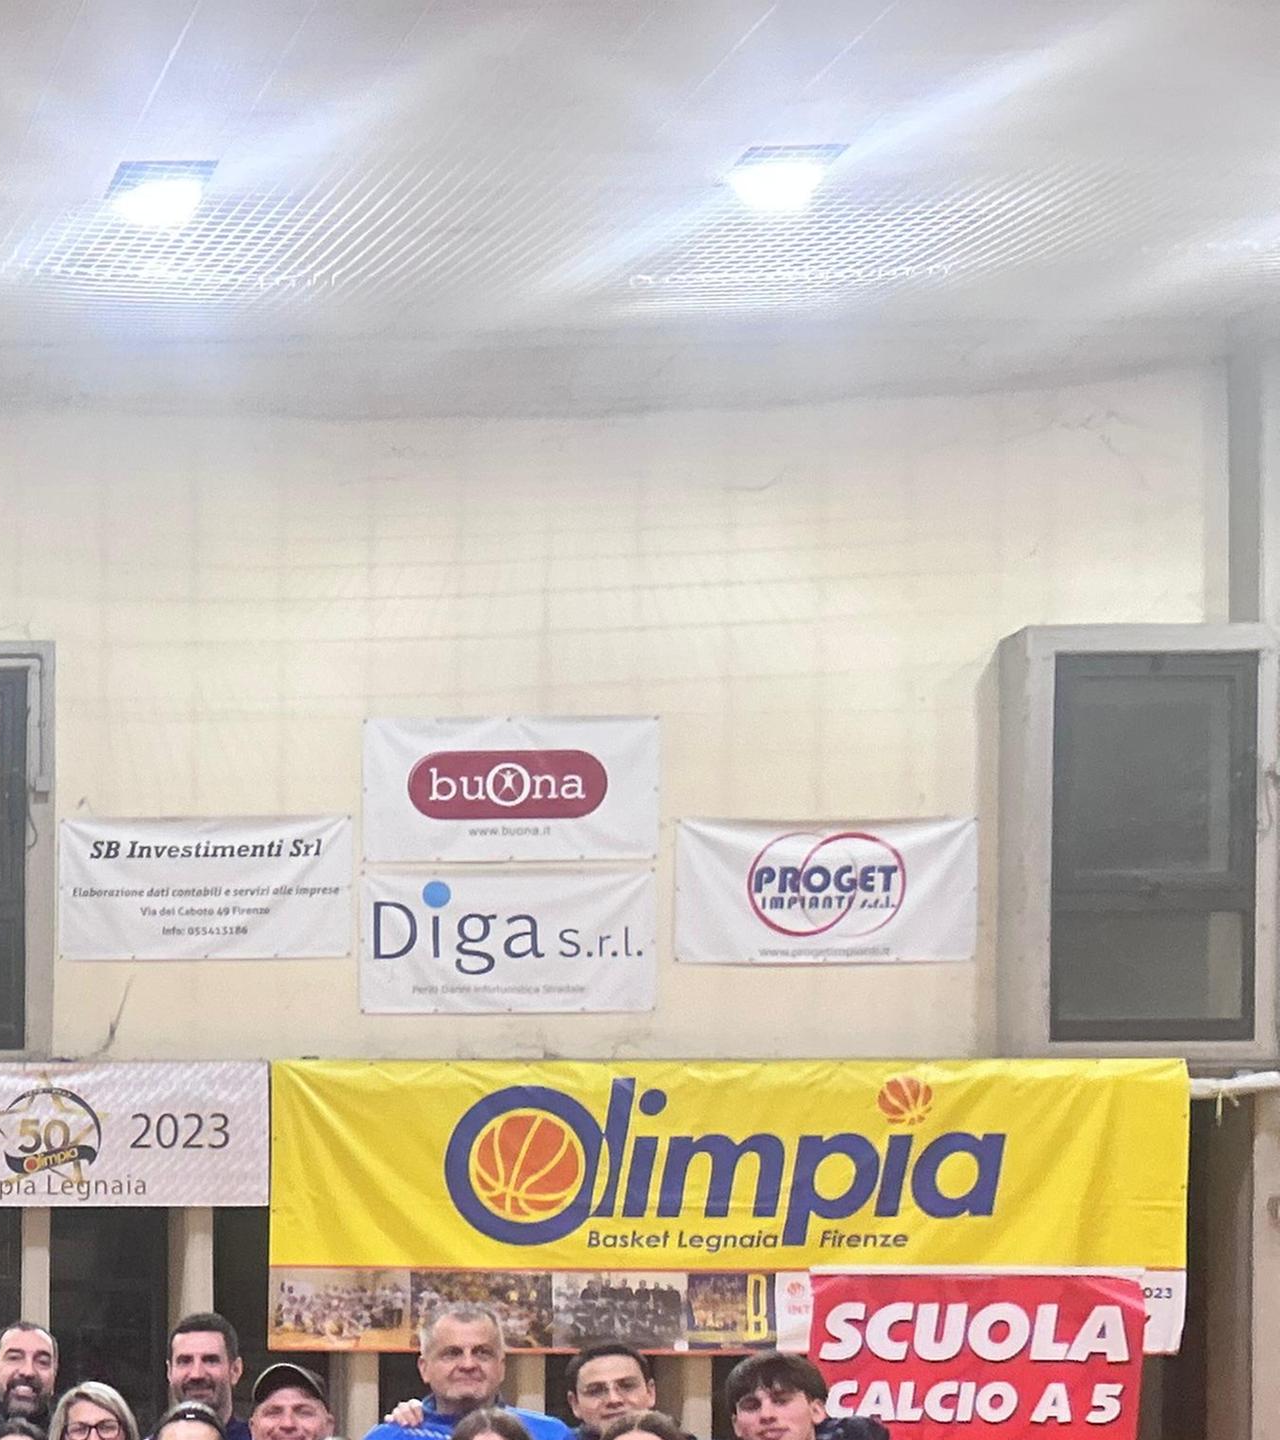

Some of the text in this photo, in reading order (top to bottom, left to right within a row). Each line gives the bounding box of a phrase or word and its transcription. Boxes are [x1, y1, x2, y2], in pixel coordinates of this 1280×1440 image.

[468, 826, 551, 837] www.buona.it
[89, 838, 323, 860] SB Investimenti Srl
[72, 887, 144, 898] Elaborazione
[146, 887, 170, 898] dati
[171, 886, 223, 898] contabili
[233, 886, 270, 897] servizi
[273, 885, 293, 896] alle
[295, 885, 340, 898] imprese
[753, 864, 898, 894] PROGET
[140, 906, 157, 917] Via
[177, 906, 215, 917] Caboto
[216, 906, 231, 917] 49
[232, 905, 270, 916] Firenze
[162, 925, 184, 936] Info:
[373, 881, 644, 975] Diga s.r.l.
[18, 1118, 71, 1154] 50
[129, 1113, 231, 1150] 2023
[444, 1076, 1008, 1247] Olimpia
[46, 1174, 148, 1201] Legnaia
[587, 1228, 910, 1254] Basket Legnaia Firenze
[819, 1301, 1130, 1363] SCUOLA
[825, 1380, 1124, 1424] CALCIO A 5
